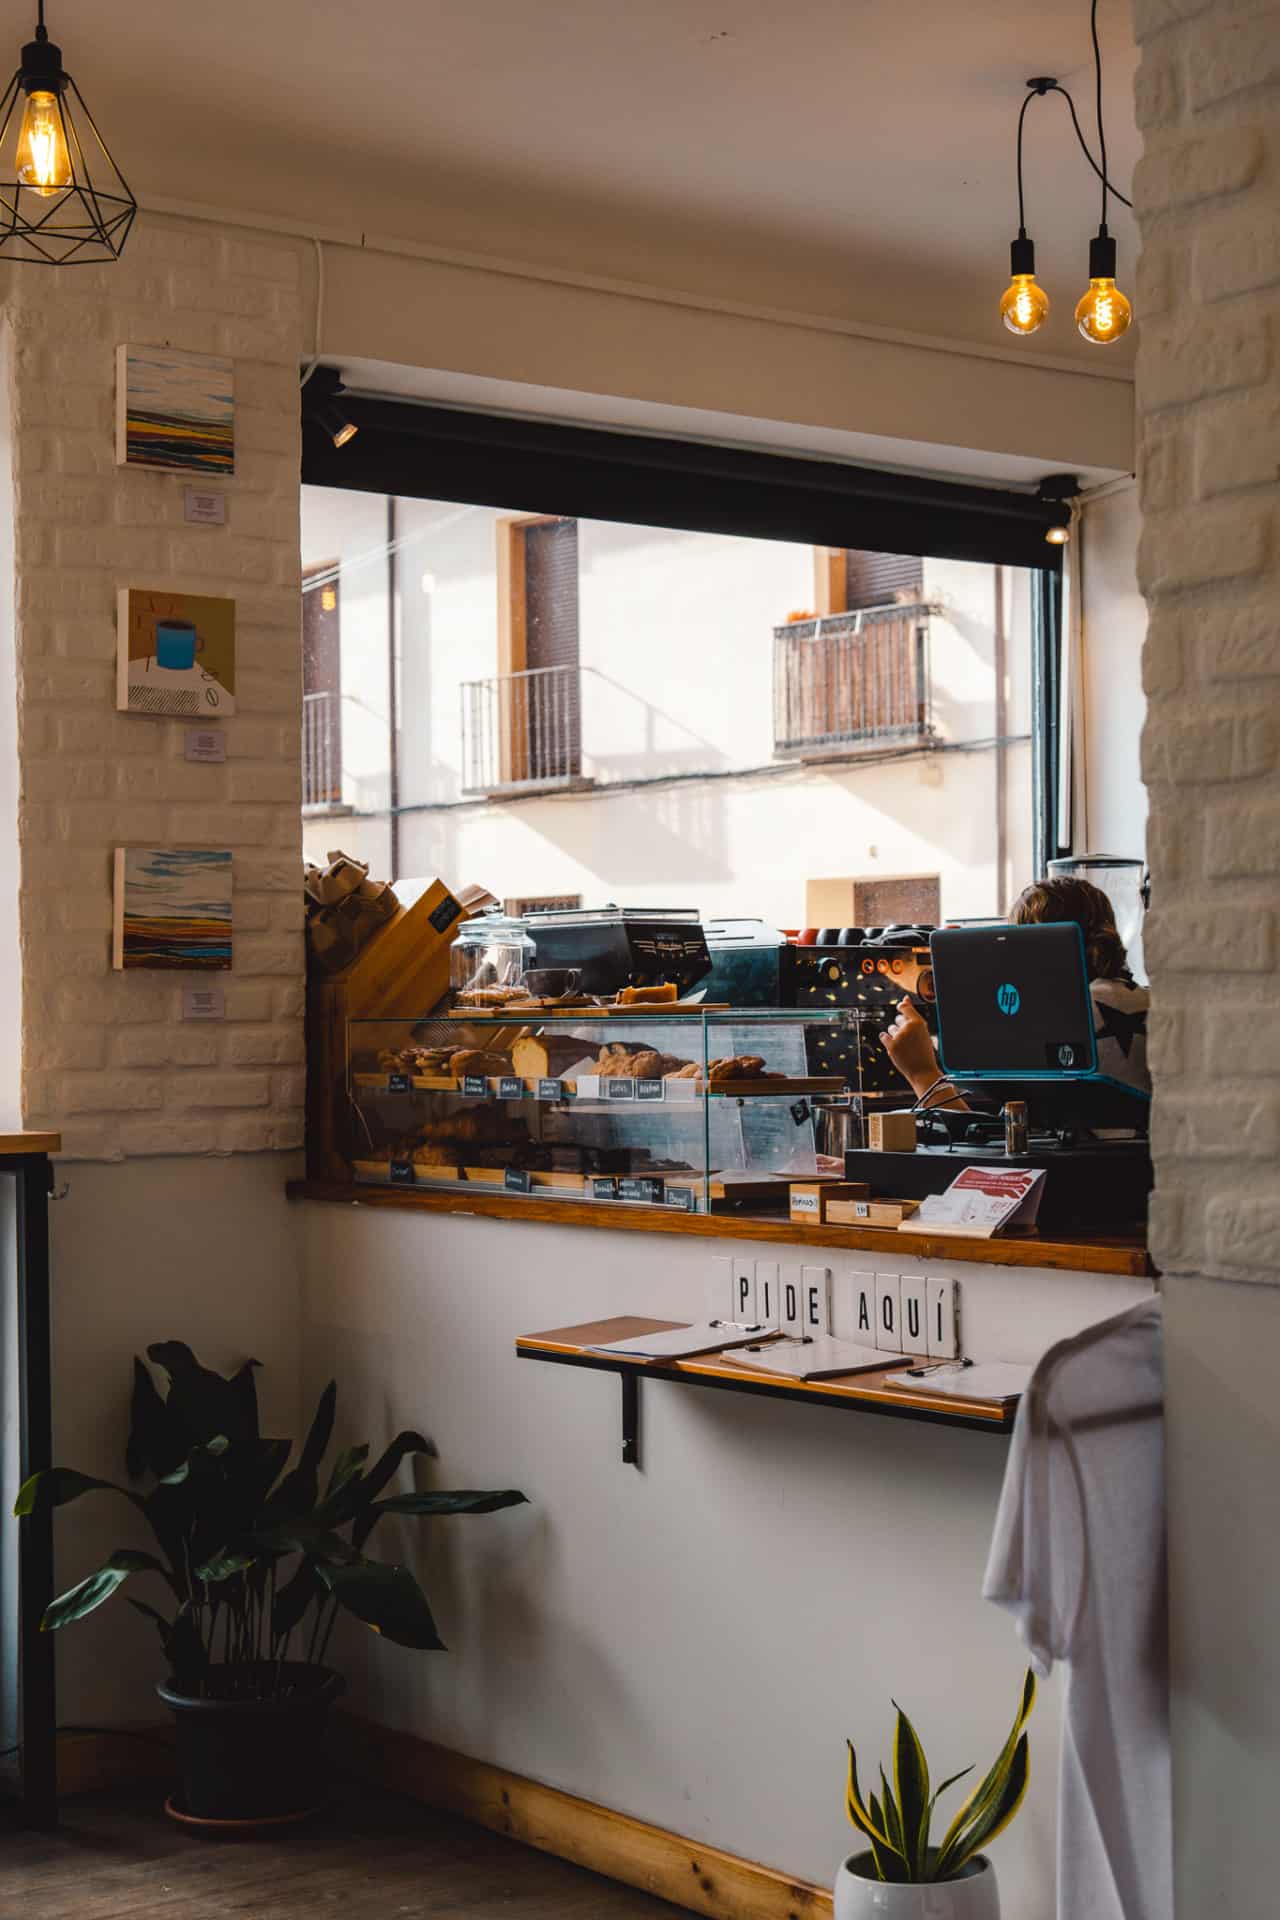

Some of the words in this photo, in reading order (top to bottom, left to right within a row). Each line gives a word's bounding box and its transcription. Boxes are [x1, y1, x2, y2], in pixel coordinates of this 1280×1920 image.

[998, 984, 1019, 1015] hp
[1059, 1045, 1073, 1066] hp
[739, 1277, 819, 1325] PIDE
[858, 1289, 944, 1342] AQUÍ
